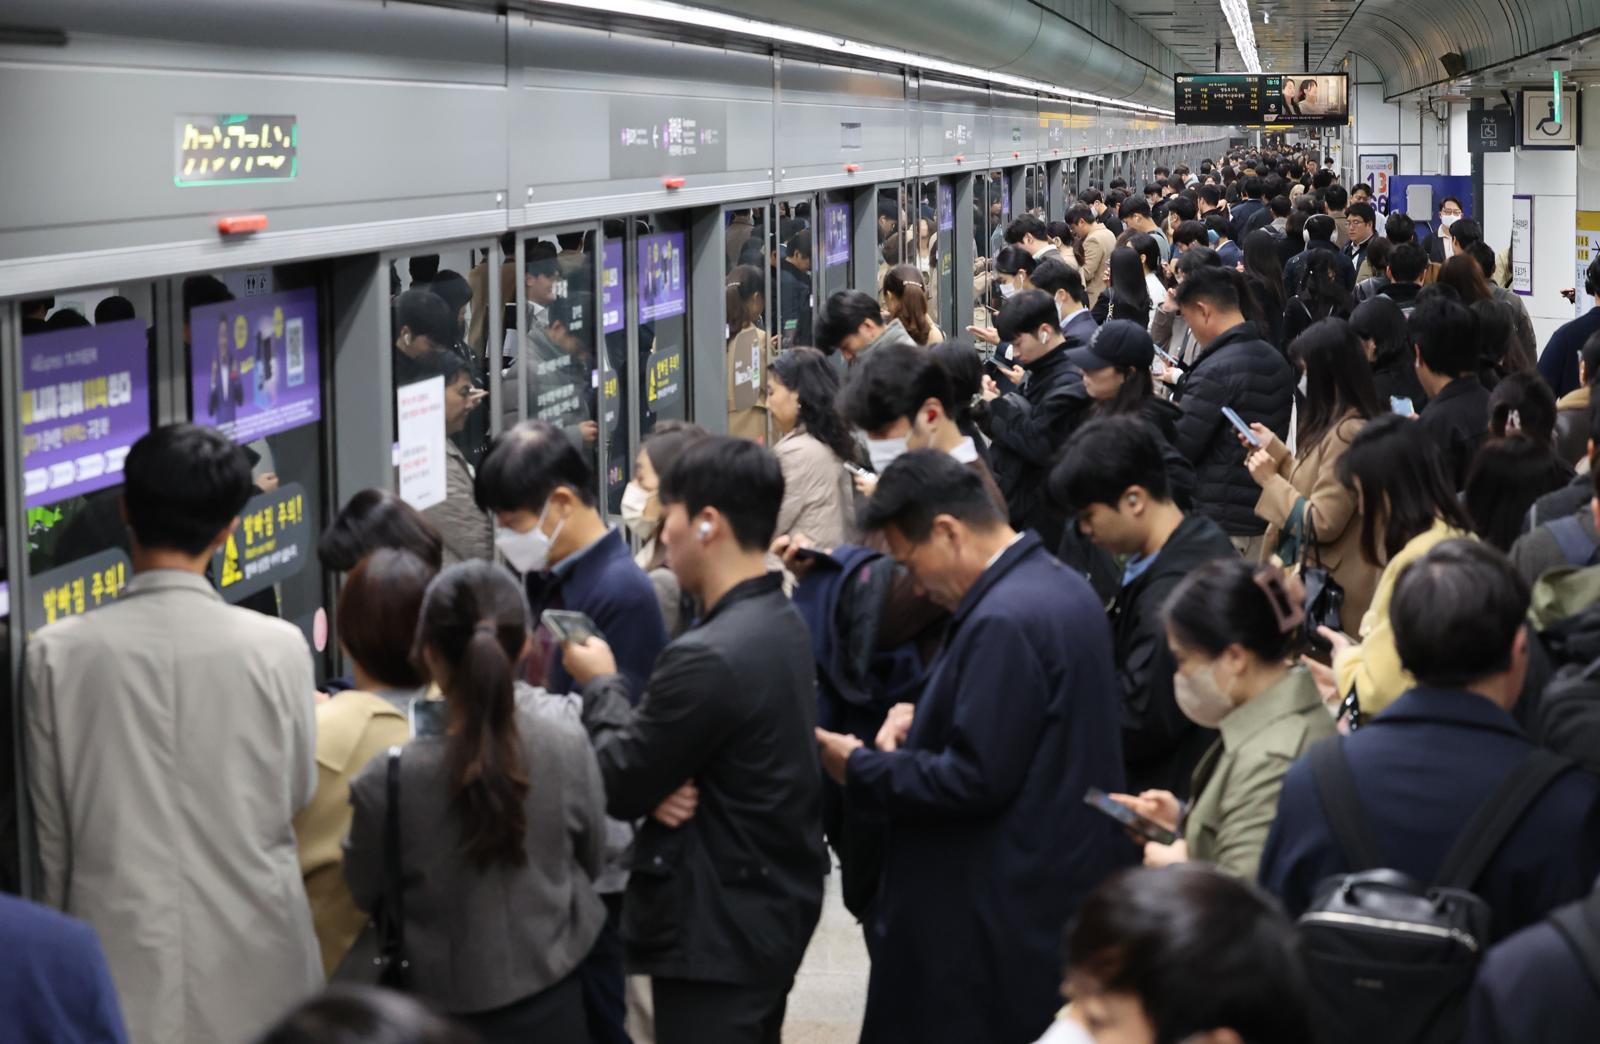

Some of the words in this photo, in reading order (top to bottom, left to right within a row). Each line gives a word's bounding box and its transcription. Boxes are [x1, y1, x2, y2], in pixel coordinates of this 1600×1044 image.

[243, 505, 274, 545] 발빠짐
[277, 494, 302, 530] 주의!
[43, 576, 85, 625] 발빠짐
[91, 562, 125, 605] 주의!
